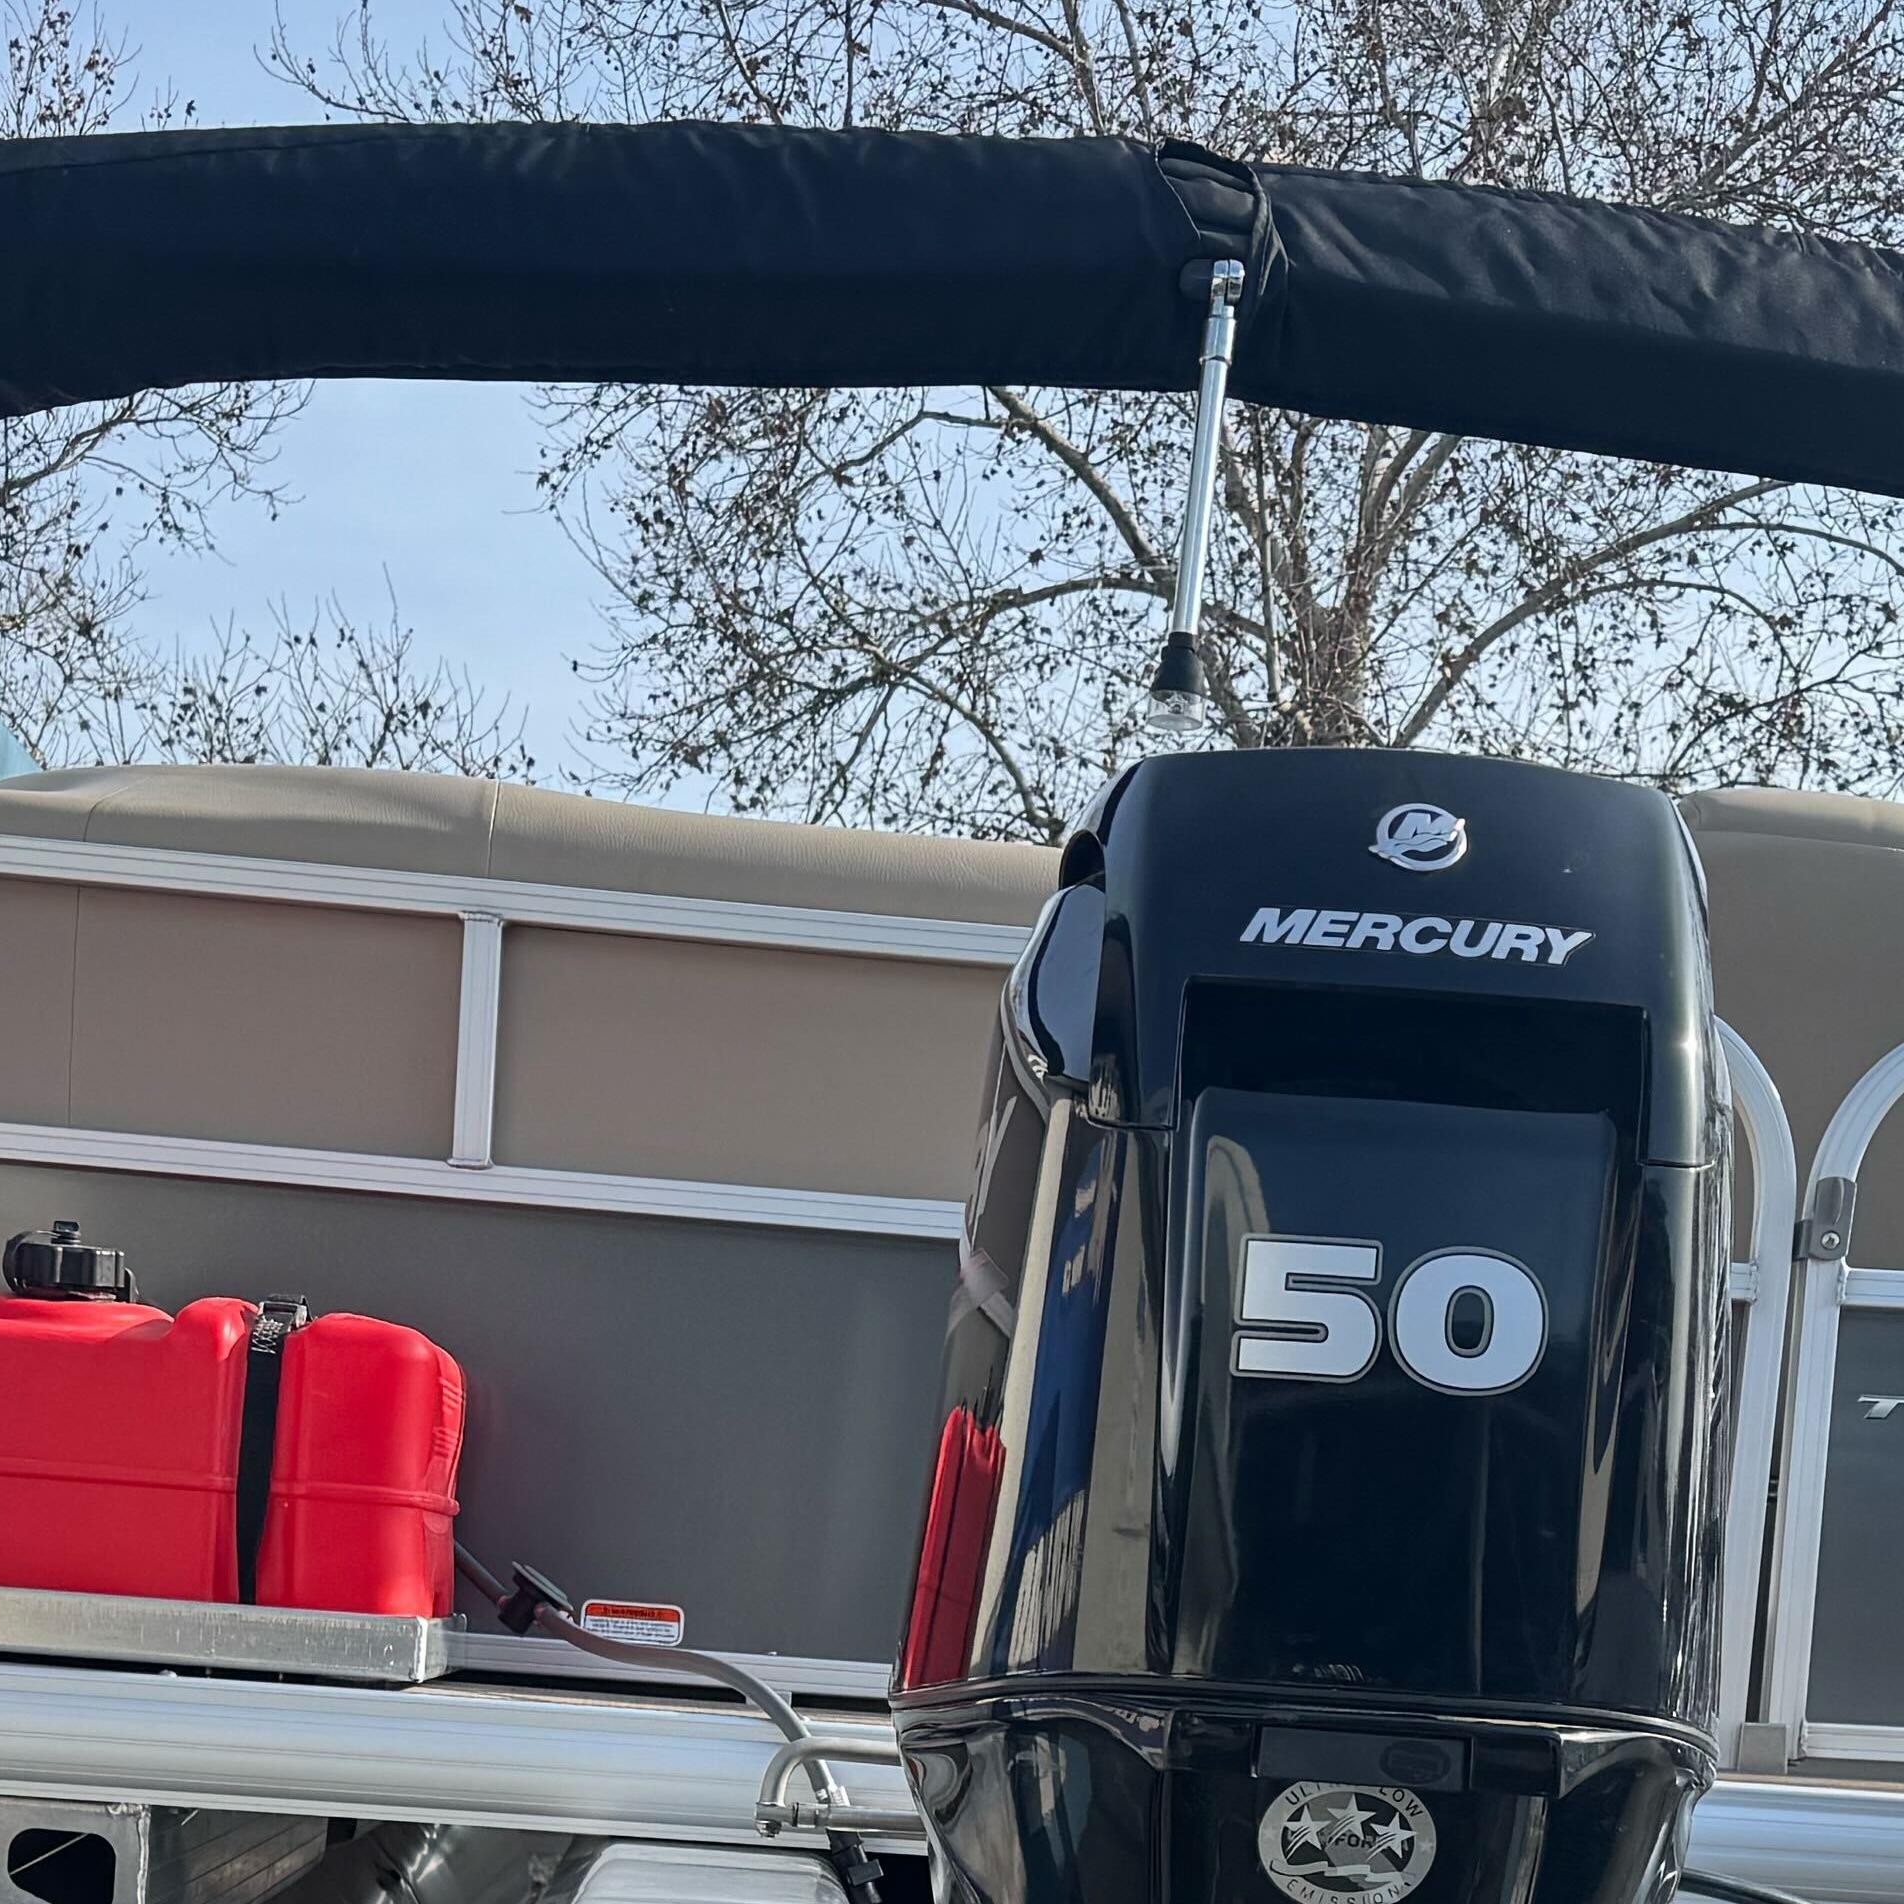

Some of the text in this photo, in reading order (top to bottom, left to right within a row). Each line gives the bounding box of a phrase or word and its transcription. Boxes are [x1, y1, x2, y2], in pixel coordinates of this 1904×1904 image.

[1240, 907, 1593, 965] MERCURY
[1229, 1232, 1549, 1397] 50
[1378, 1786, 1424, 1818] LOW
